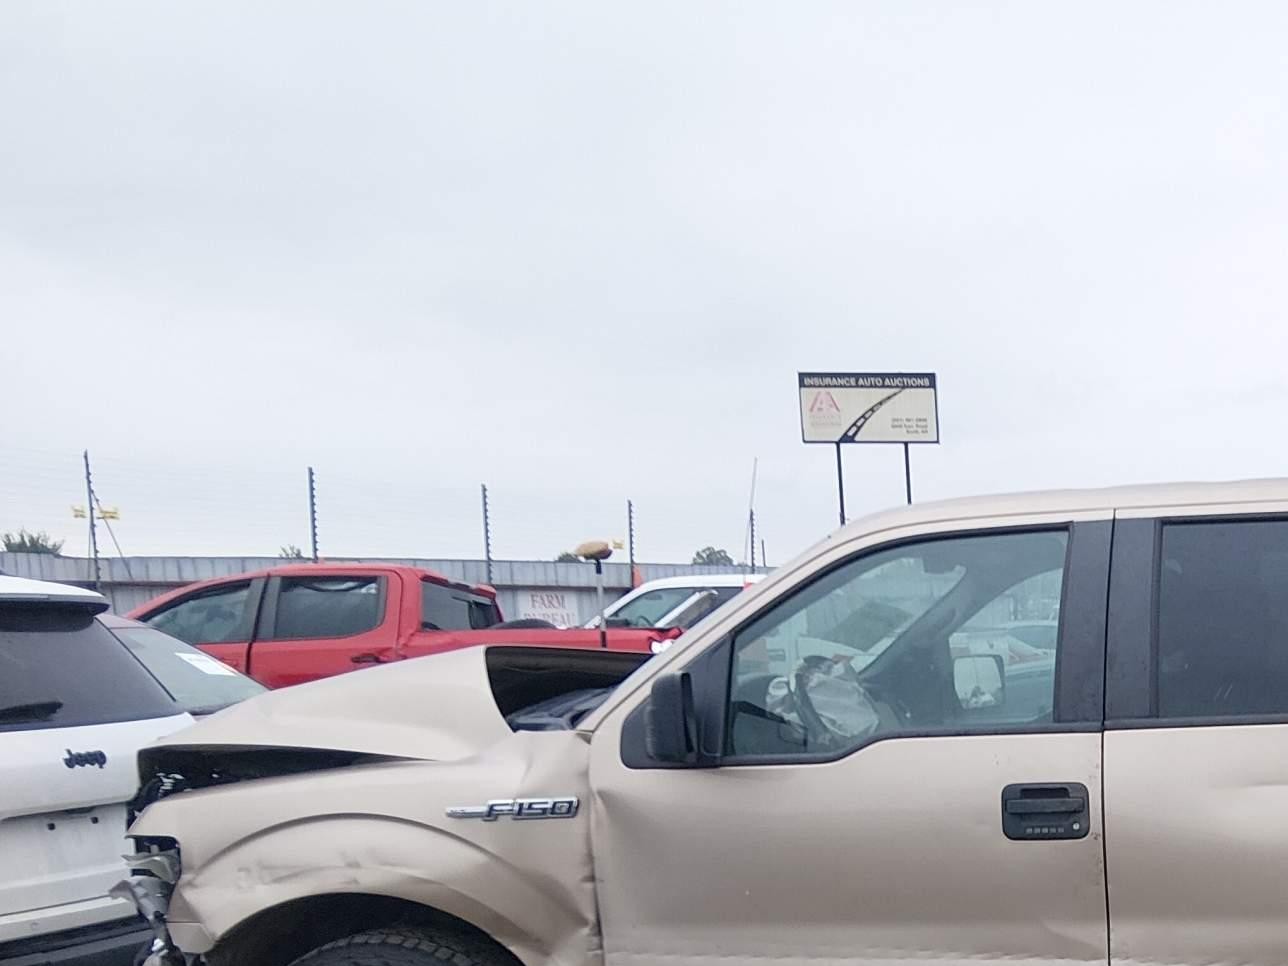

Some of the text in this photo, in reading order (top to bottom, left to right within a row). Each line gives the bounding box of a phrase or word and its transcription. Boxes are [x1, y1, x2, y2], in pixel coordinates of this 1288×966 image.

[804, 377, 930, 387] INSURANCE AUTO AUCTIONS
[530, 593, 566, 609] FARM
[63, 749, 107, 769] Jeep
